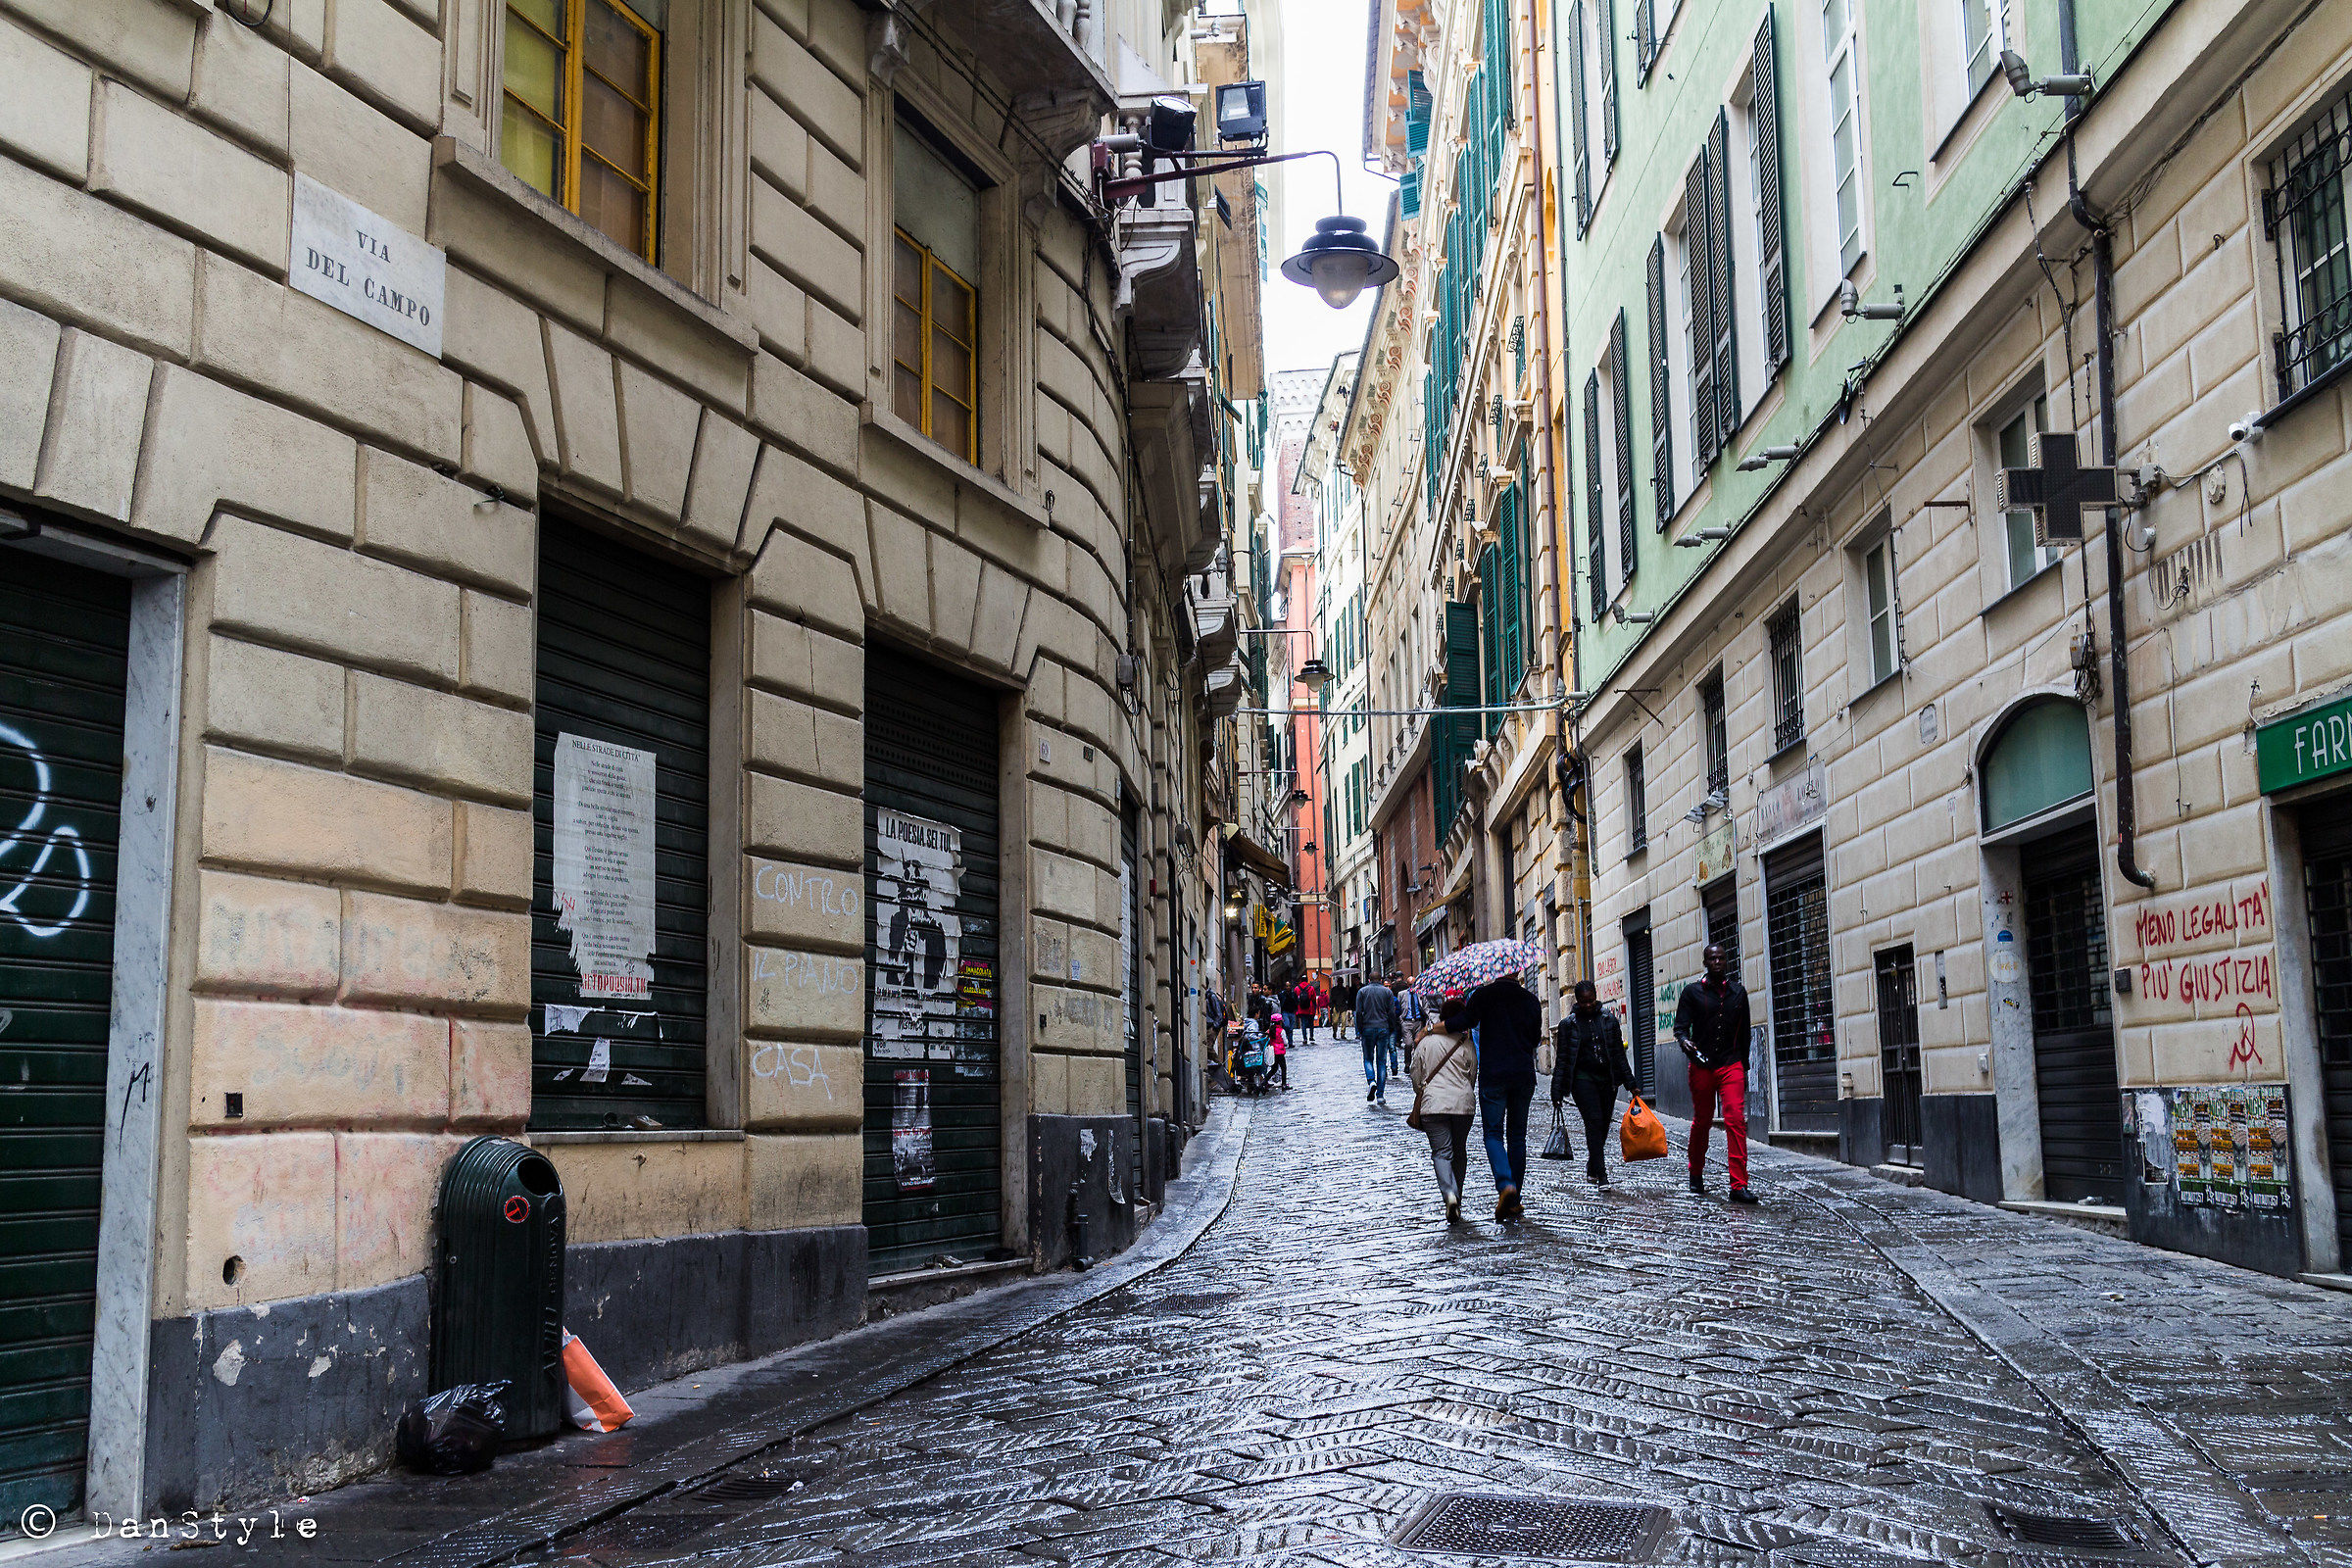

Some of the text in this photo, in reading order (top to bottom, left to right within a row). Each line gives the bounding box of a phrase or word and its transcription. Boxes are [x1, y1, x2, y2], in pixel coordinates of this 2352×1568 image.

[356, 229, 391, 264] VIA
[306, 247, 430, 326] DEL CAMPO
[571, 739, 592, 751] NELLE
[591, 744, 614, 757] STRADE
[885, 816, 897, 840] LA
[898, 820, 925, 847] POESIA
[926, 827, 938, 850] SEI
[756, 865, 858, 915] CONTRO
[2135, 882, 2268, 948] MENO LEGALITA'
[754, 953, 858, 995] IL PIANO
[2141, 955, 2272, 1004] PIU' GIUSTIZIA
[753, 1043, 832, 1101] CASA
